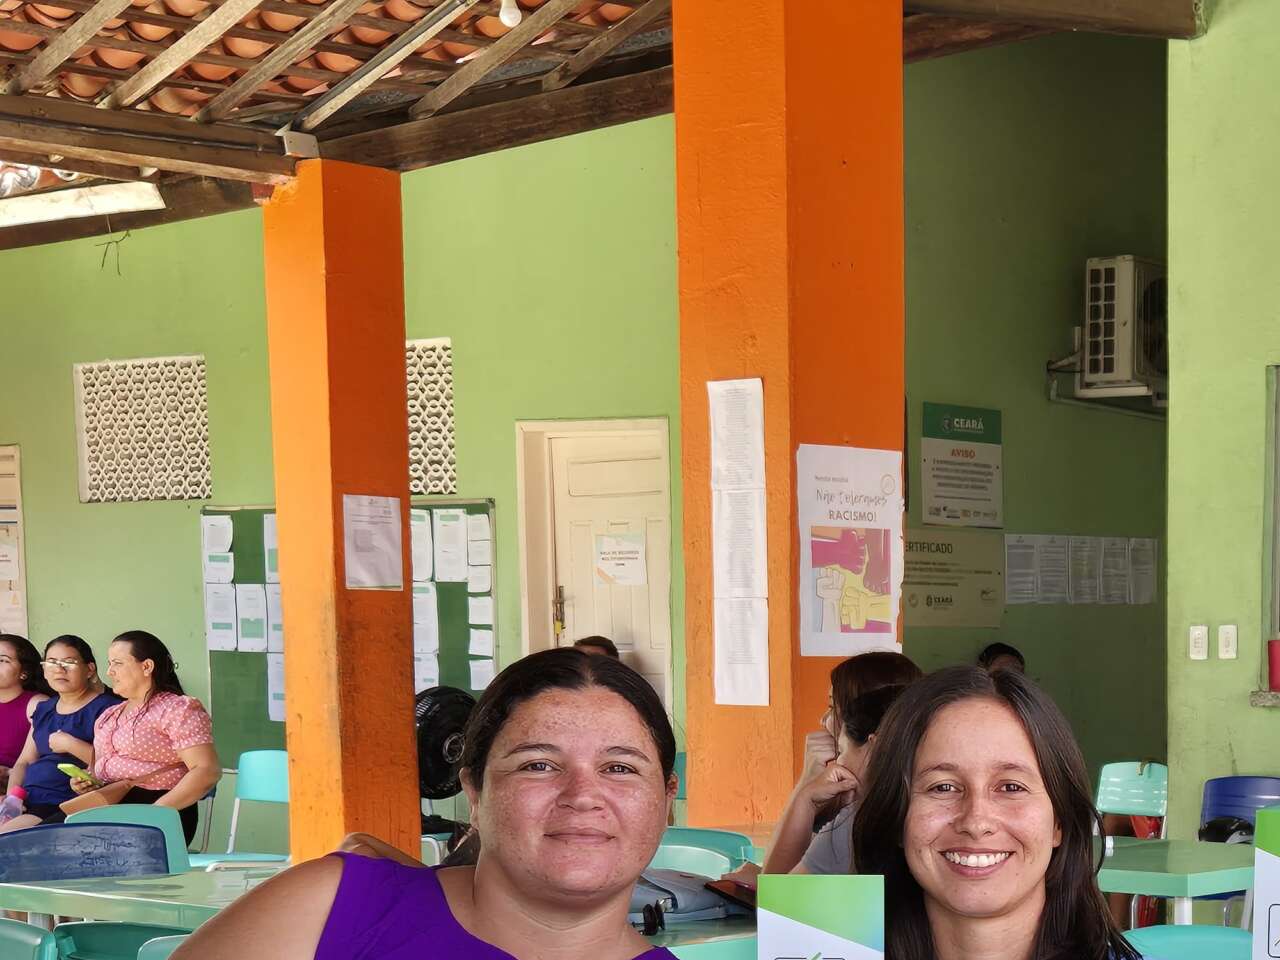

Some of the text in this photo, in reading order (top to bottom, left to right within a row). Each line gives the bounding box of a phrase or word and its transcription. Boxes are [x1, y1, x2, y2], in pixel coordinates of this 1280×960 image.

[953, 416, 984, 430] CEARÁ
[951, 448, 976, 459] AVISO
[829, 509, 877, 522] RACISMO!
[905, 542, 953, 554] ERTIFICADO
